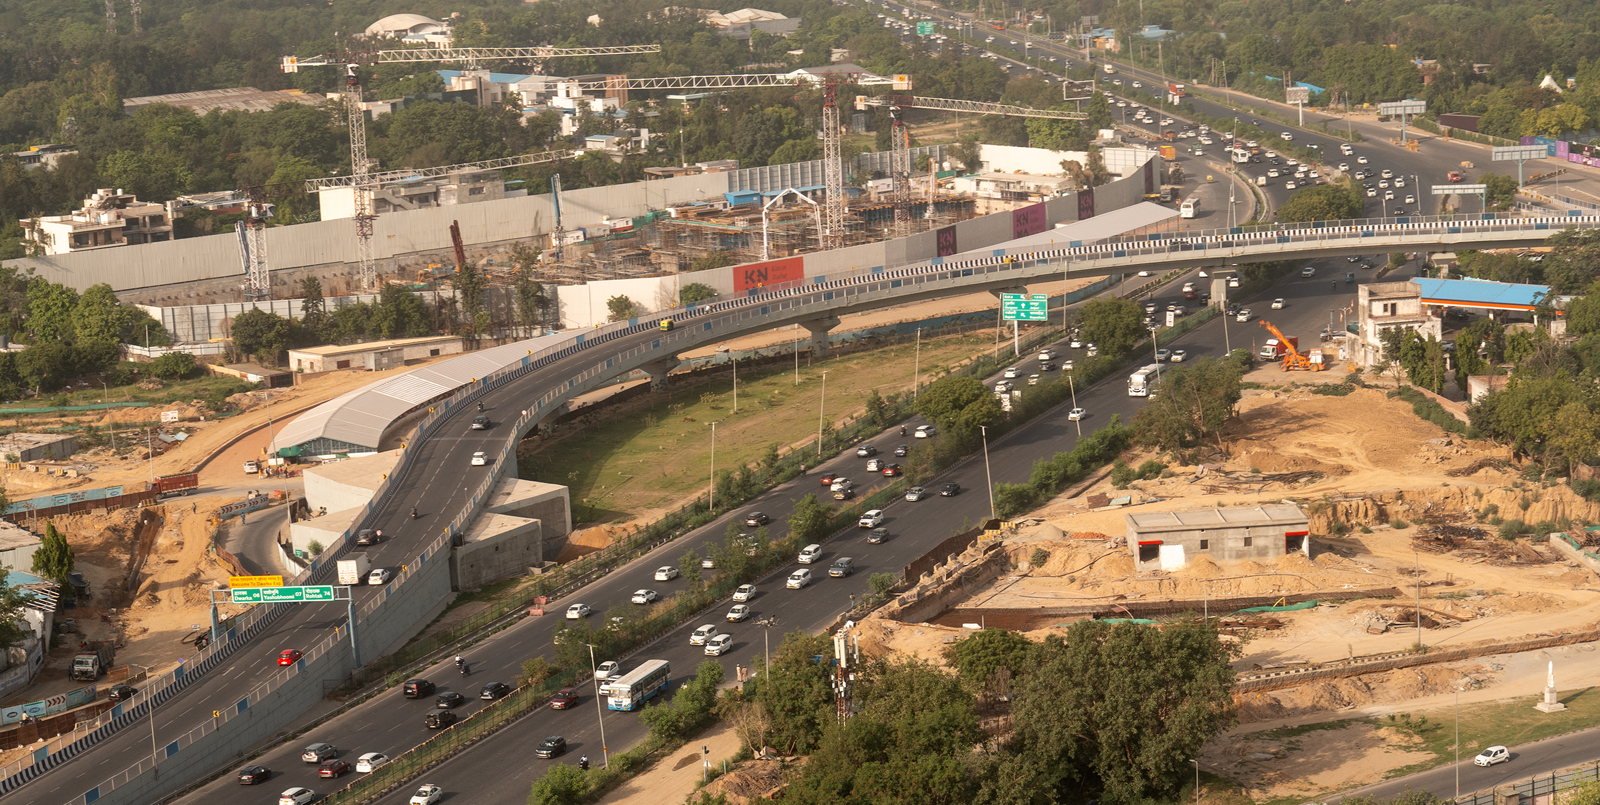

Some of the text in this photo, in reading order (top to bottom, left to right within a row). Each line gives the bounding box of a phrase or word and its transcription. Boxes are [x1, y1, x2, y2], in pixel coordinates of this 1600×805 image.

[1016, 210, 1029, 227] KN
[939, 230, 954, 247] KN
[745, 267, 768, 285] KN
